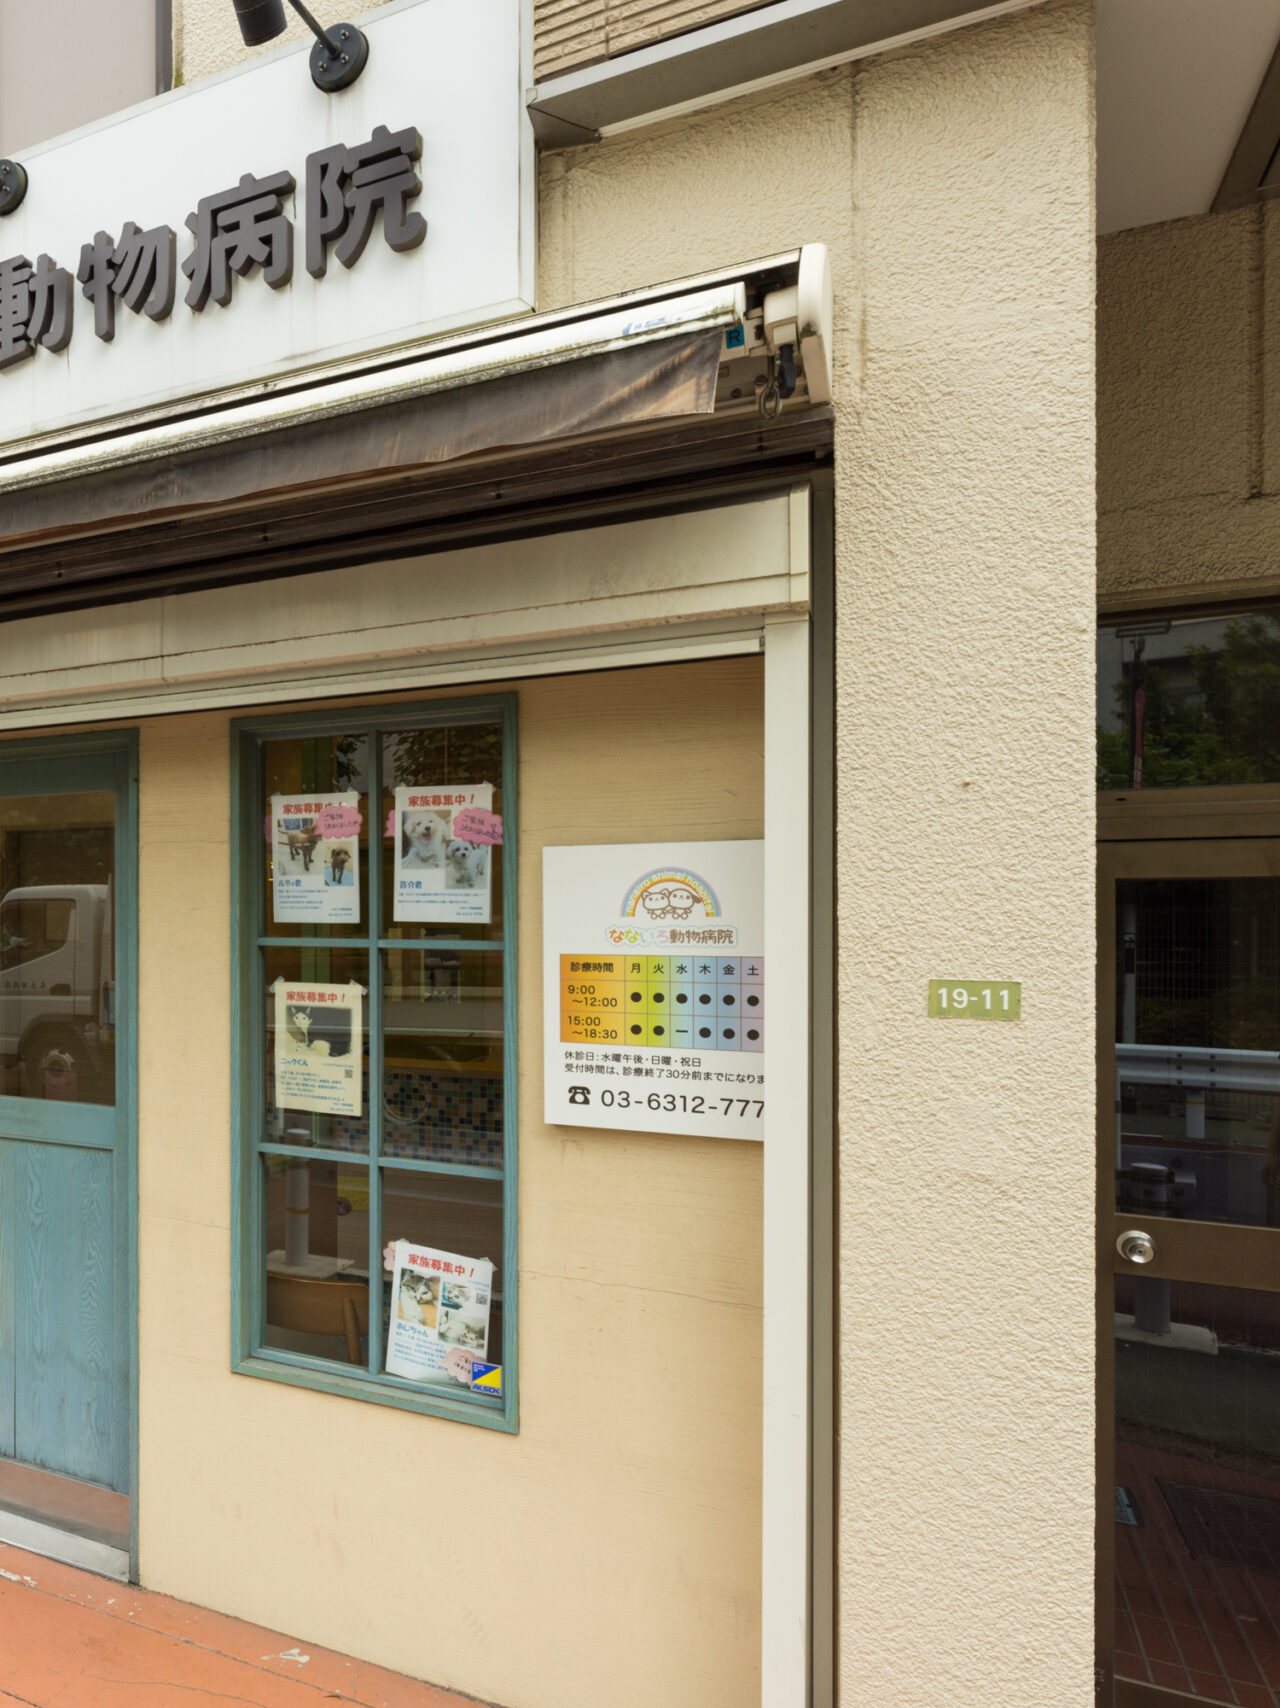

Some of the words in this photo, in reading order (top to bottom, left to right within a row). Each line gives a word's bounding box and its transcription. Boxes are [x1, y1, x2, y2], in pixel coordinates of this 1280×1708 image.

[728, 329, 741, 344] R
[609, 928, 734, 945] なないろ動物病院
[570, 961, 614, 973] 診療時間
[631, 963, 641, 973] 月
[653, 963, 664, 974] 火
[676, 963, 688, 975] 水
[699, 964, 711, 975] 木
[723, 964, 735, 976] 金
[747, 965, 760, 976] 土
[567, 984, 596, 995] 9:00
[938, 988, 1009, 1011] 19-11
[567, 1015, 601, 1026] 15:00
[601, 1089, 764, 1118] 03-6312-777
[408, 1254, 475, 1278] 家族募集中！
